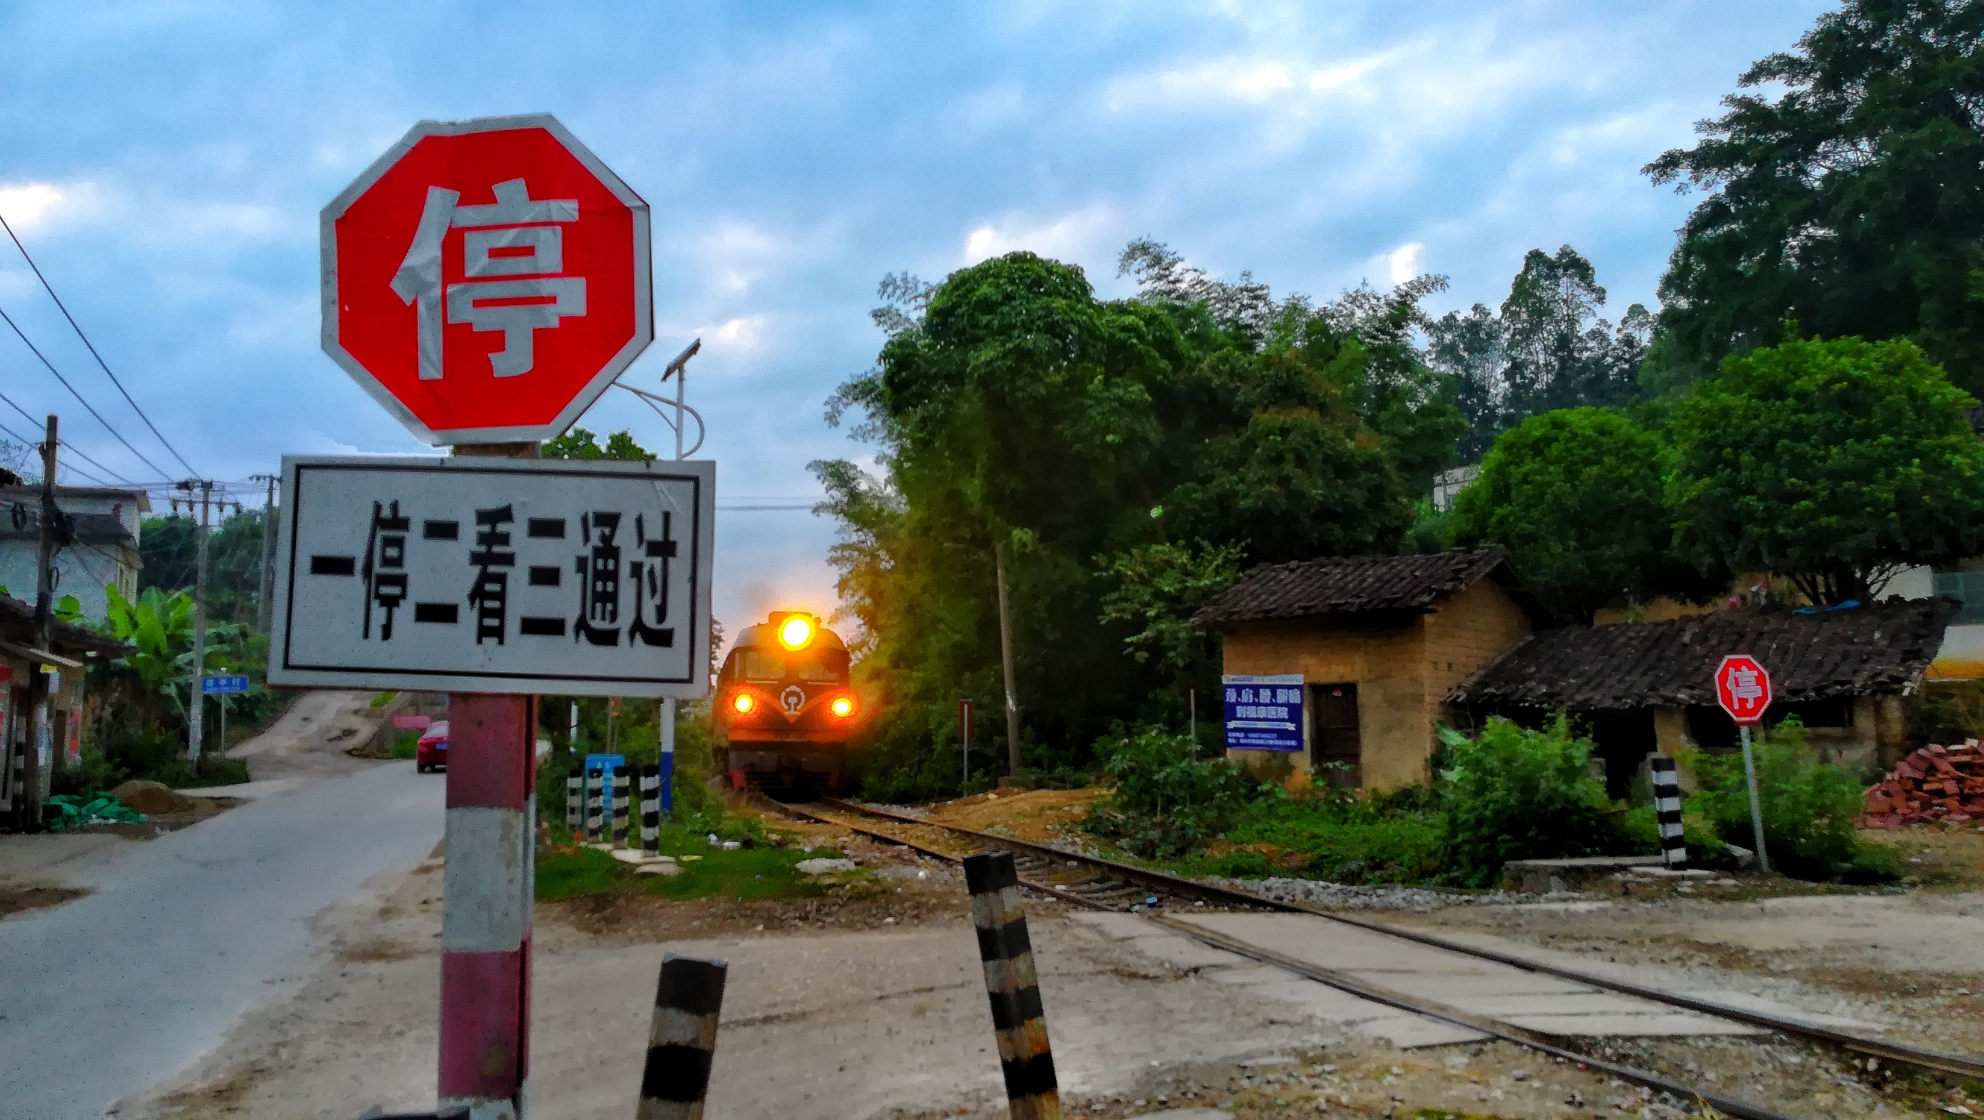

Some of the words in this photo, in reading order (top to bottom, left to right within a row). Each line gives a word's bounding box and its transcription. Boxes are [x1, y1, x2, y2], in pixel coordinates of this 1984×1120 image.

[390, 178, 587, 380] 停
[310, 499, 677, 648] 一停二看三通过
[1726, 665, 1762, 710] 停
